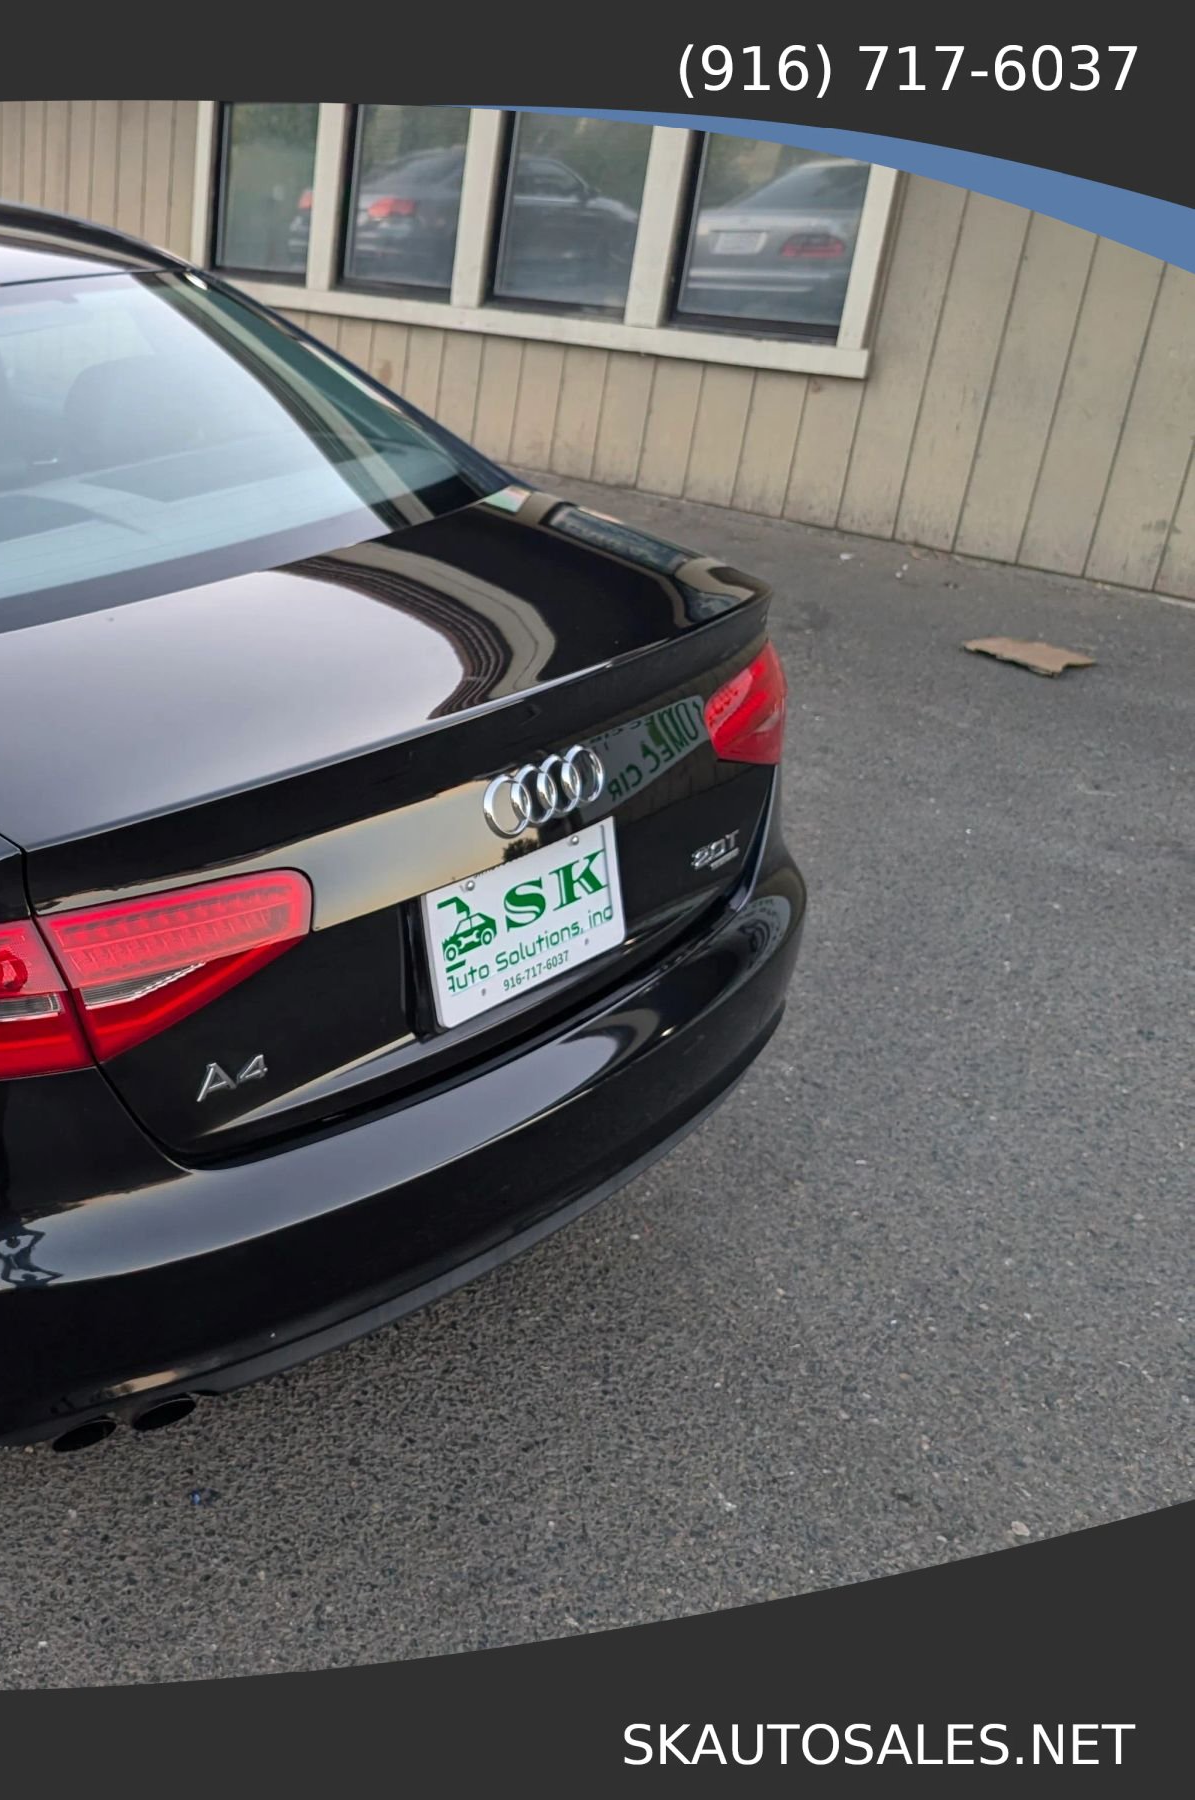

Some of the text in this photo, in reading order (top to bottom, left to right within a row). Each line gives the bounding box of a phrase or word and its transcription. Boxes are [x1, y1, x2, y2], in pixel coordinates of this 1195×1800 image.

[504, 848, 608, 932] SK
[495, 921, 584, 973] Solutions,
[503, 950, 570, 992] 916-717-6037
[197, 1054, 268, 1102] A4
